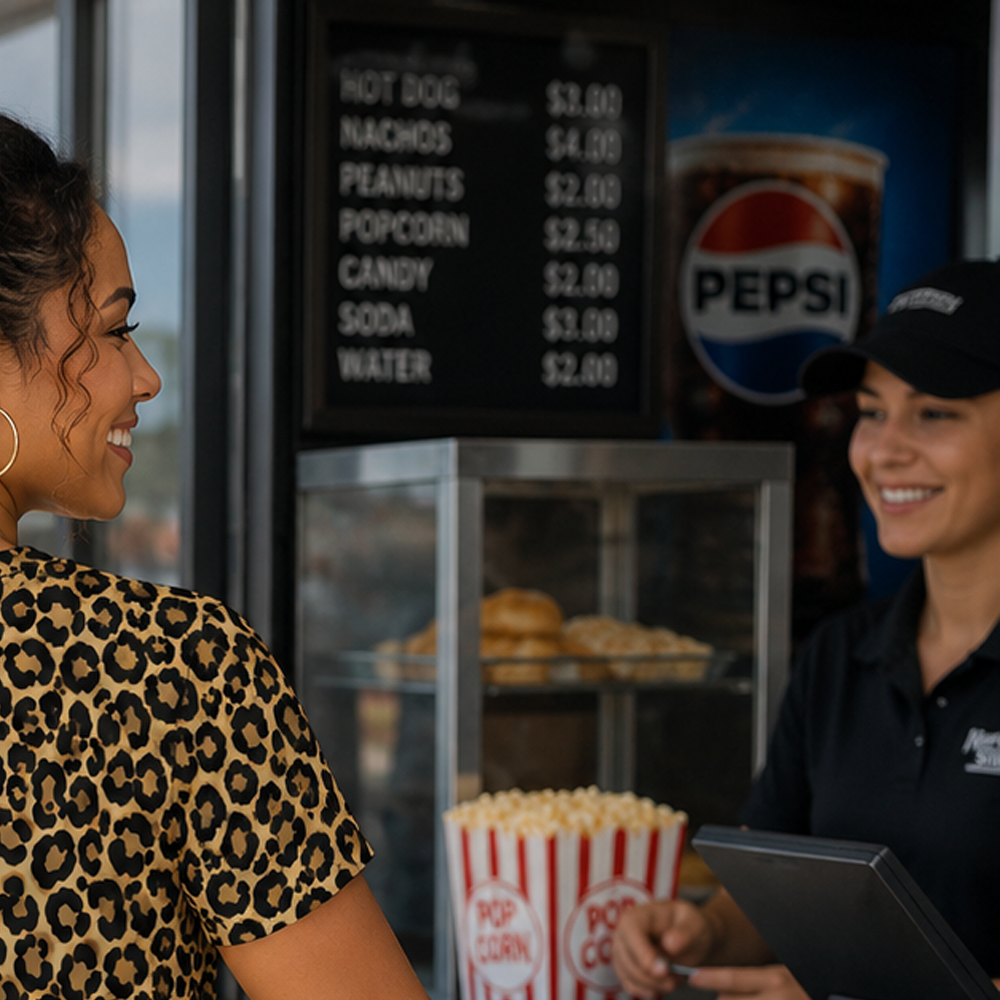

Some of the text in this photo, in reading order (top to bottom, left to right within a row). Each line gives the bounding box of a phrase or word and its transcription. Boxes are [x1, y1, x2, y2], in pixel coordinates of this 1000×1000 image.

[340, 69, 623, 121] HOT DOG $3.00
[339, 114, 623, 165] NACHOS $4.00
[338, 161, 622, 210] PEANUTS $2.00
[338, 207, 621, 255] POPCORN $2.50
[337, 254, 620, 299] CANDY $2.00
[694, 267, 847, 317] PEPSI
[337, 300, 619, 344] SODA $3.00
[336, 346, 619, 389] WATER $2.00
[477, 899, 517, 928] POP
[477, 933, 532, 964] CORN
